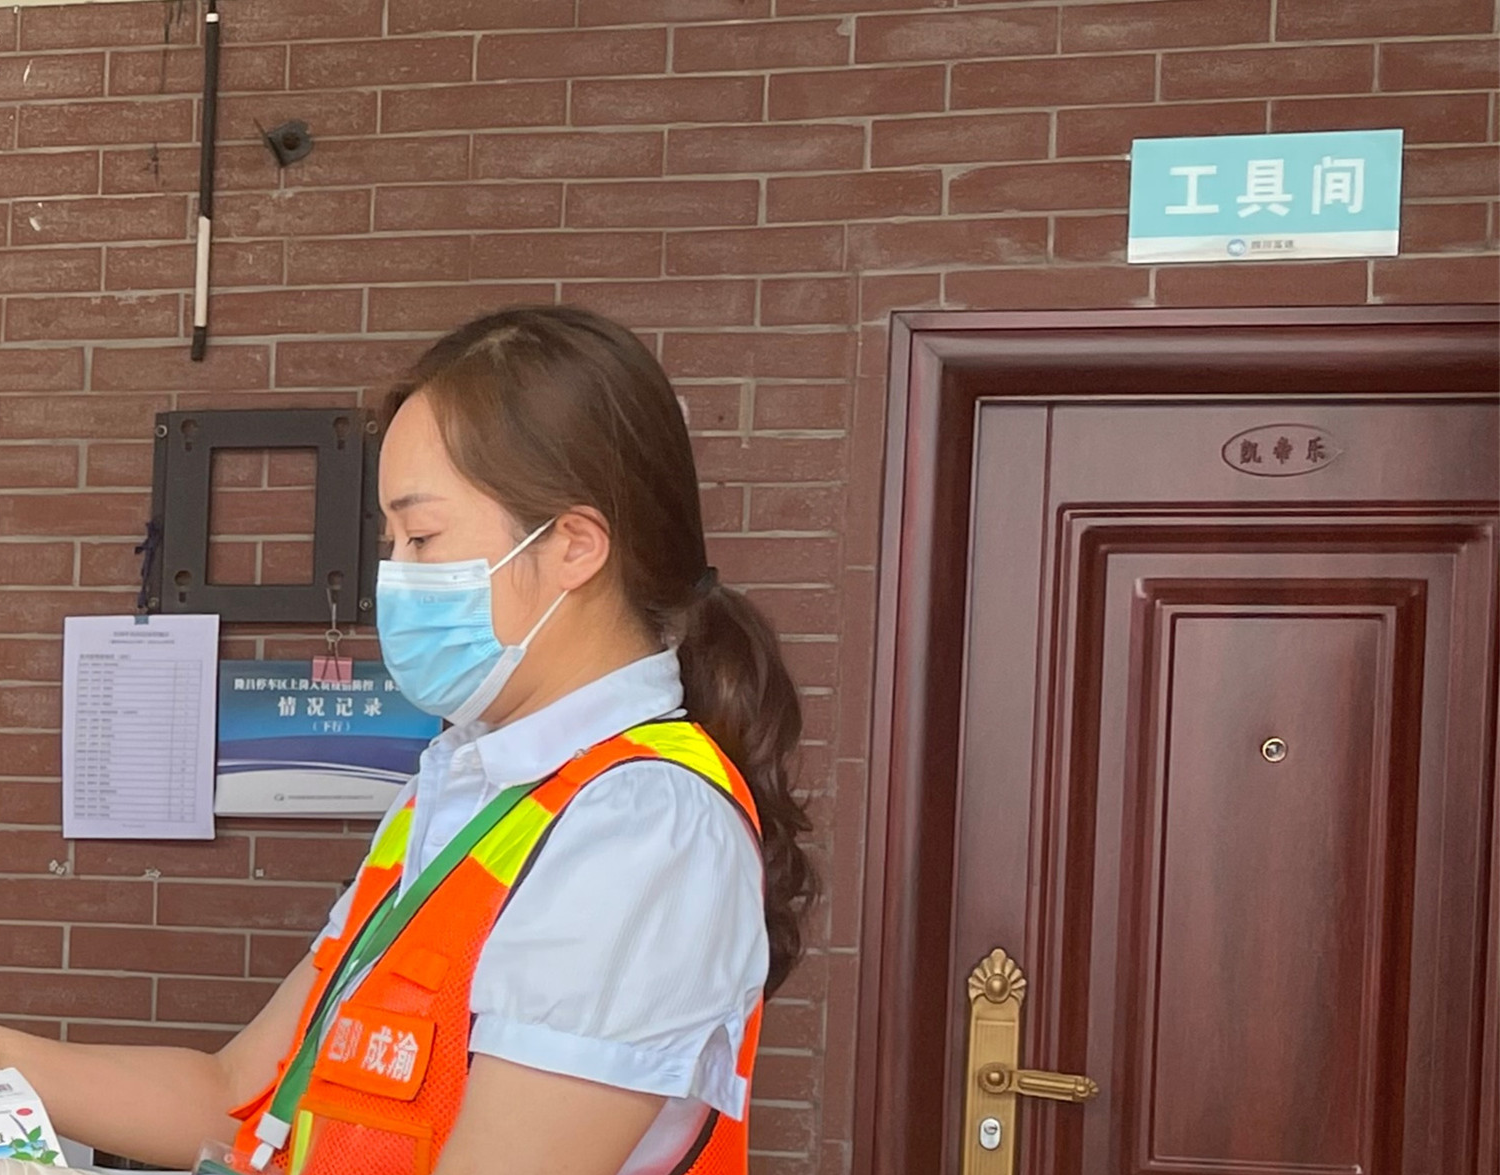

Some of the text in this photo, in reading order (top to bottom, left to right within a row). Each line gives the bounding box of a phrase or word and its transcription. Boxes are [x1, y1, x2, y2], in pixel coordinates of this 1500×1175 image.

[1165, 156, 1365, 218] 工具间
[278, 696, 382, 717] 情况记录
